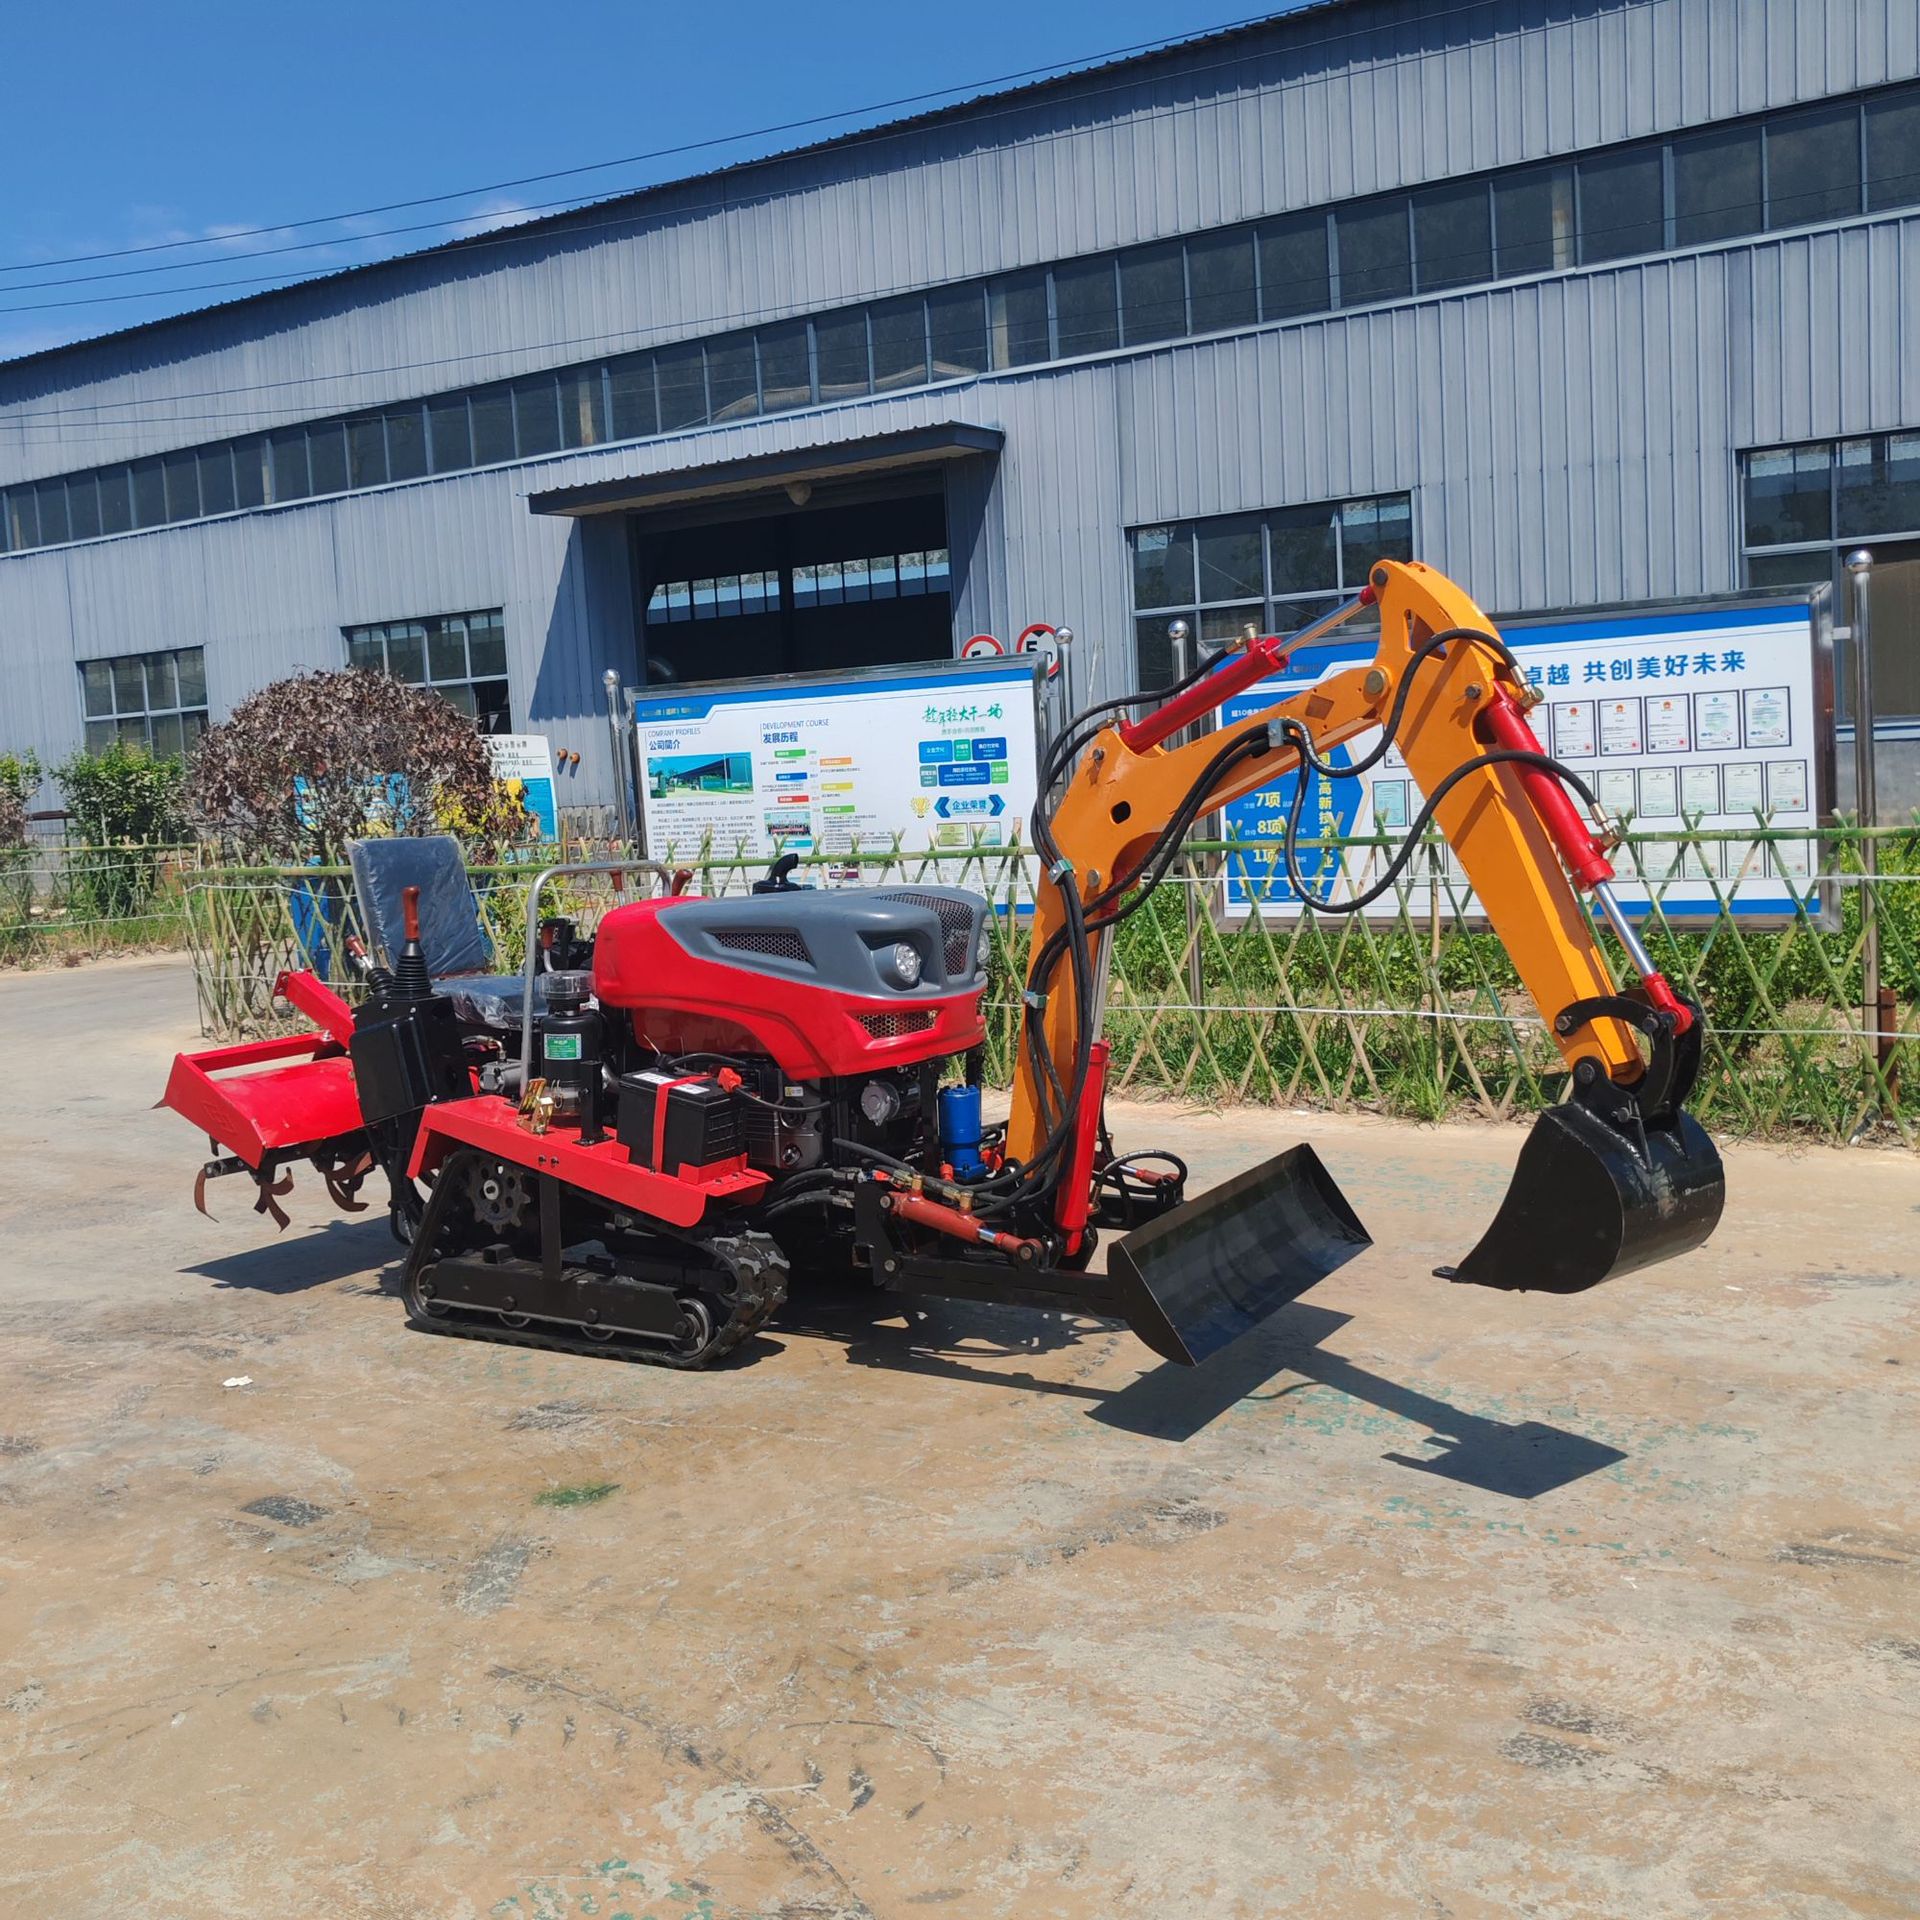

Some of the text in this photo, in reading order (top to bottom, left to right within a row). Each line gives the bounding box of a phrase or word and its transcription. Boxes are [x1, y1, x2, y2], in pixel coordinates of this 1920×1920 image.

[1583, 650, 1746, 684] 共创美好未来
[762, 718, 829, 730] DEVELOPMENT COURSE
[648, 727, 702, 738] COMPANY PROFILES
[763, 731, 798, 743] 发展历程
[649, 739, 680, 750] 公司简介
[952, 800, 987, 810] 企业荣誉
[1254, 791, 1281, 808] 7项
[1318, 752, 1334, 868] 国高新技术业
